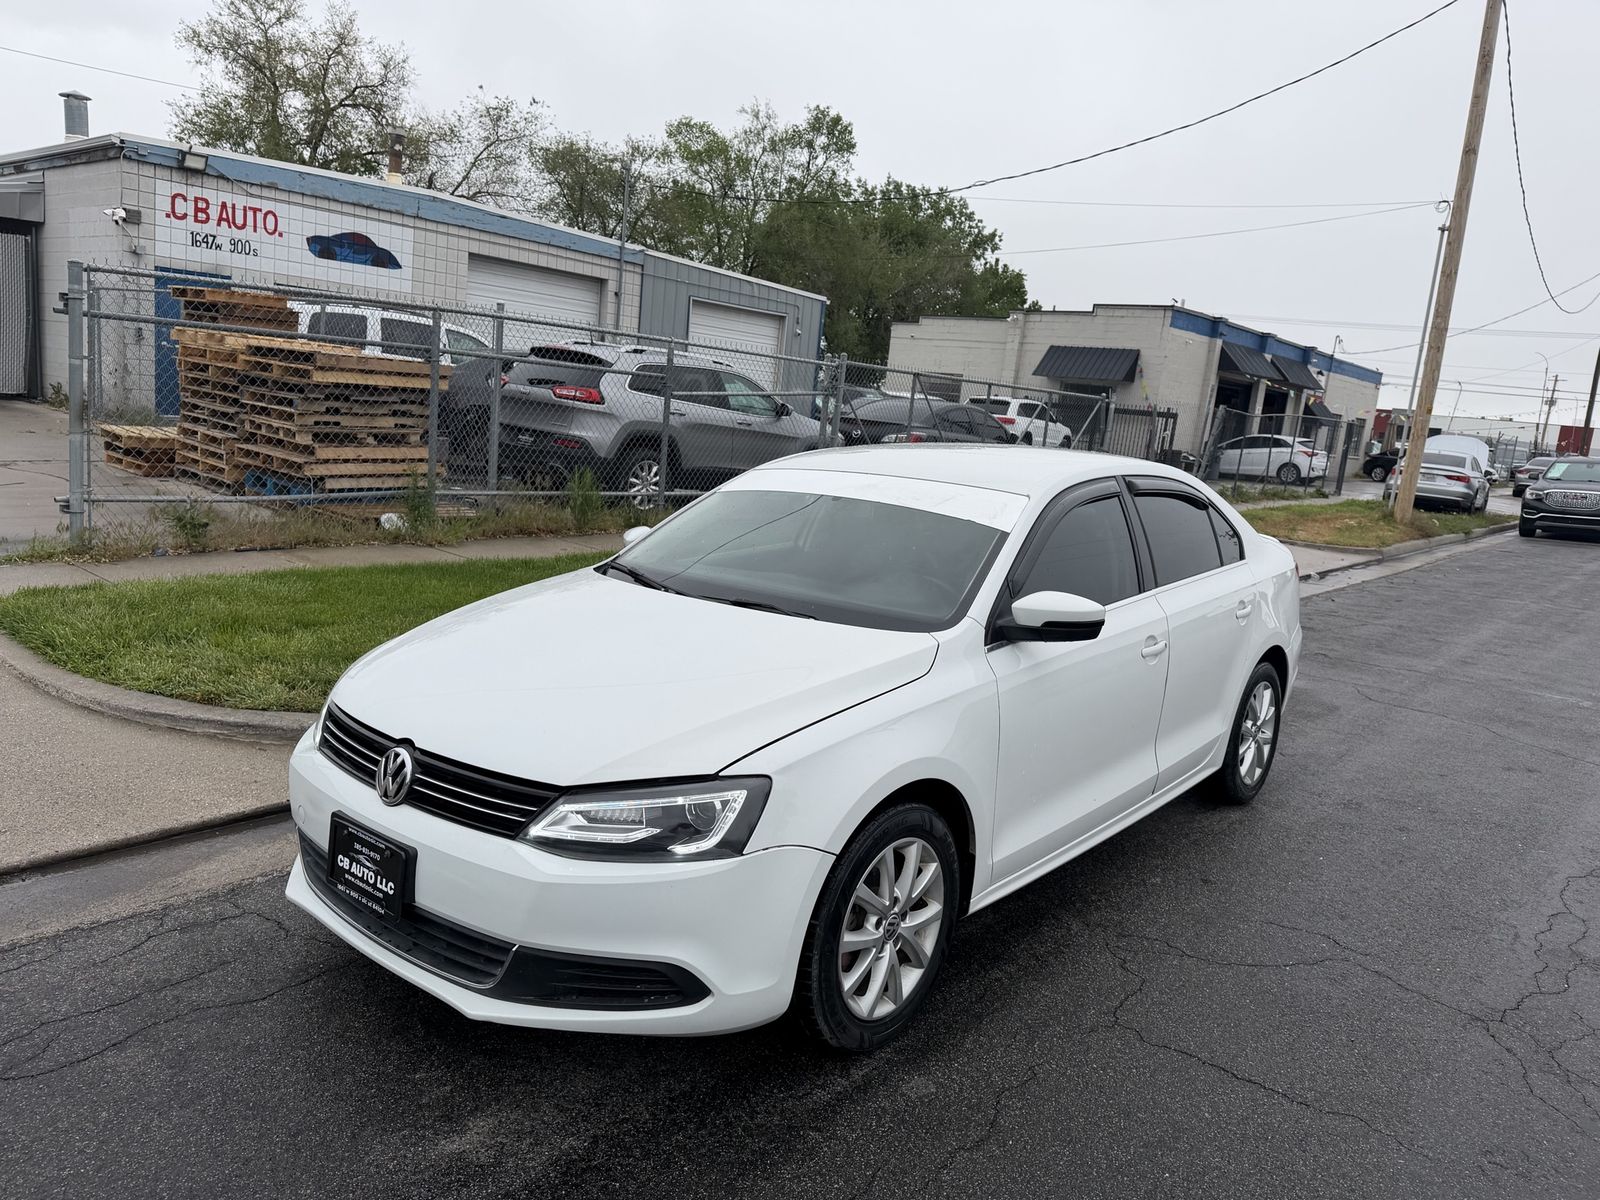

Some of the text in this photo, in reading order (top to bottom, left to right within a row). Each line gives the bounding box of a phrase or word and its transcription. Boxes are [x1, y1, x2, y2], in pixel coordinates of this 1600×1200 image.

[337, 854, 395, 895] CB AUTO LLC
